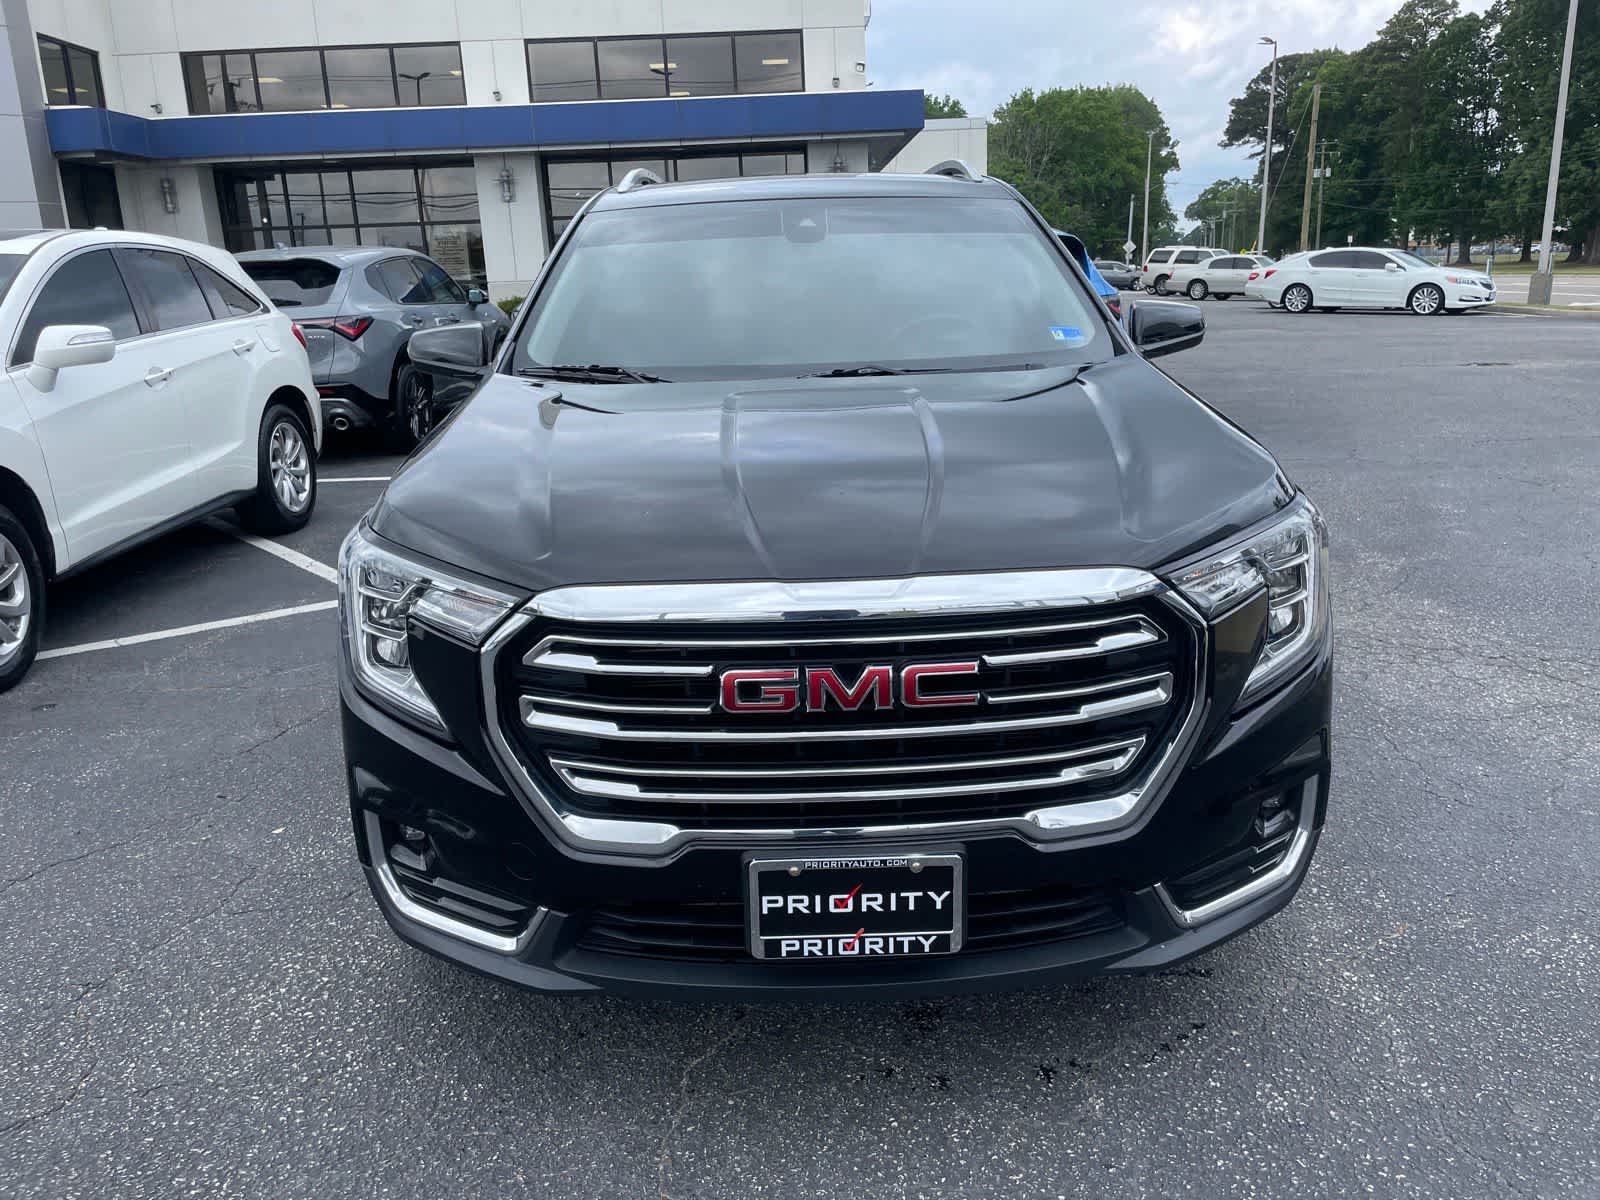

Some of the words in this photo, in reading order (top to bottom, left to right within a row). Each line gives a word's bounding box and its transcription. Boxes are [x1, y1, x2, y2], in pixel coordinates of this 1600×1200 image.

[721, 660, 980, 713] GMC
[804, 859, 908, 869] PRIORITYAUTO.COM
[762, 890, 951, 915] PRIORITY
[781, 935, 937, 957] PRIORITY
